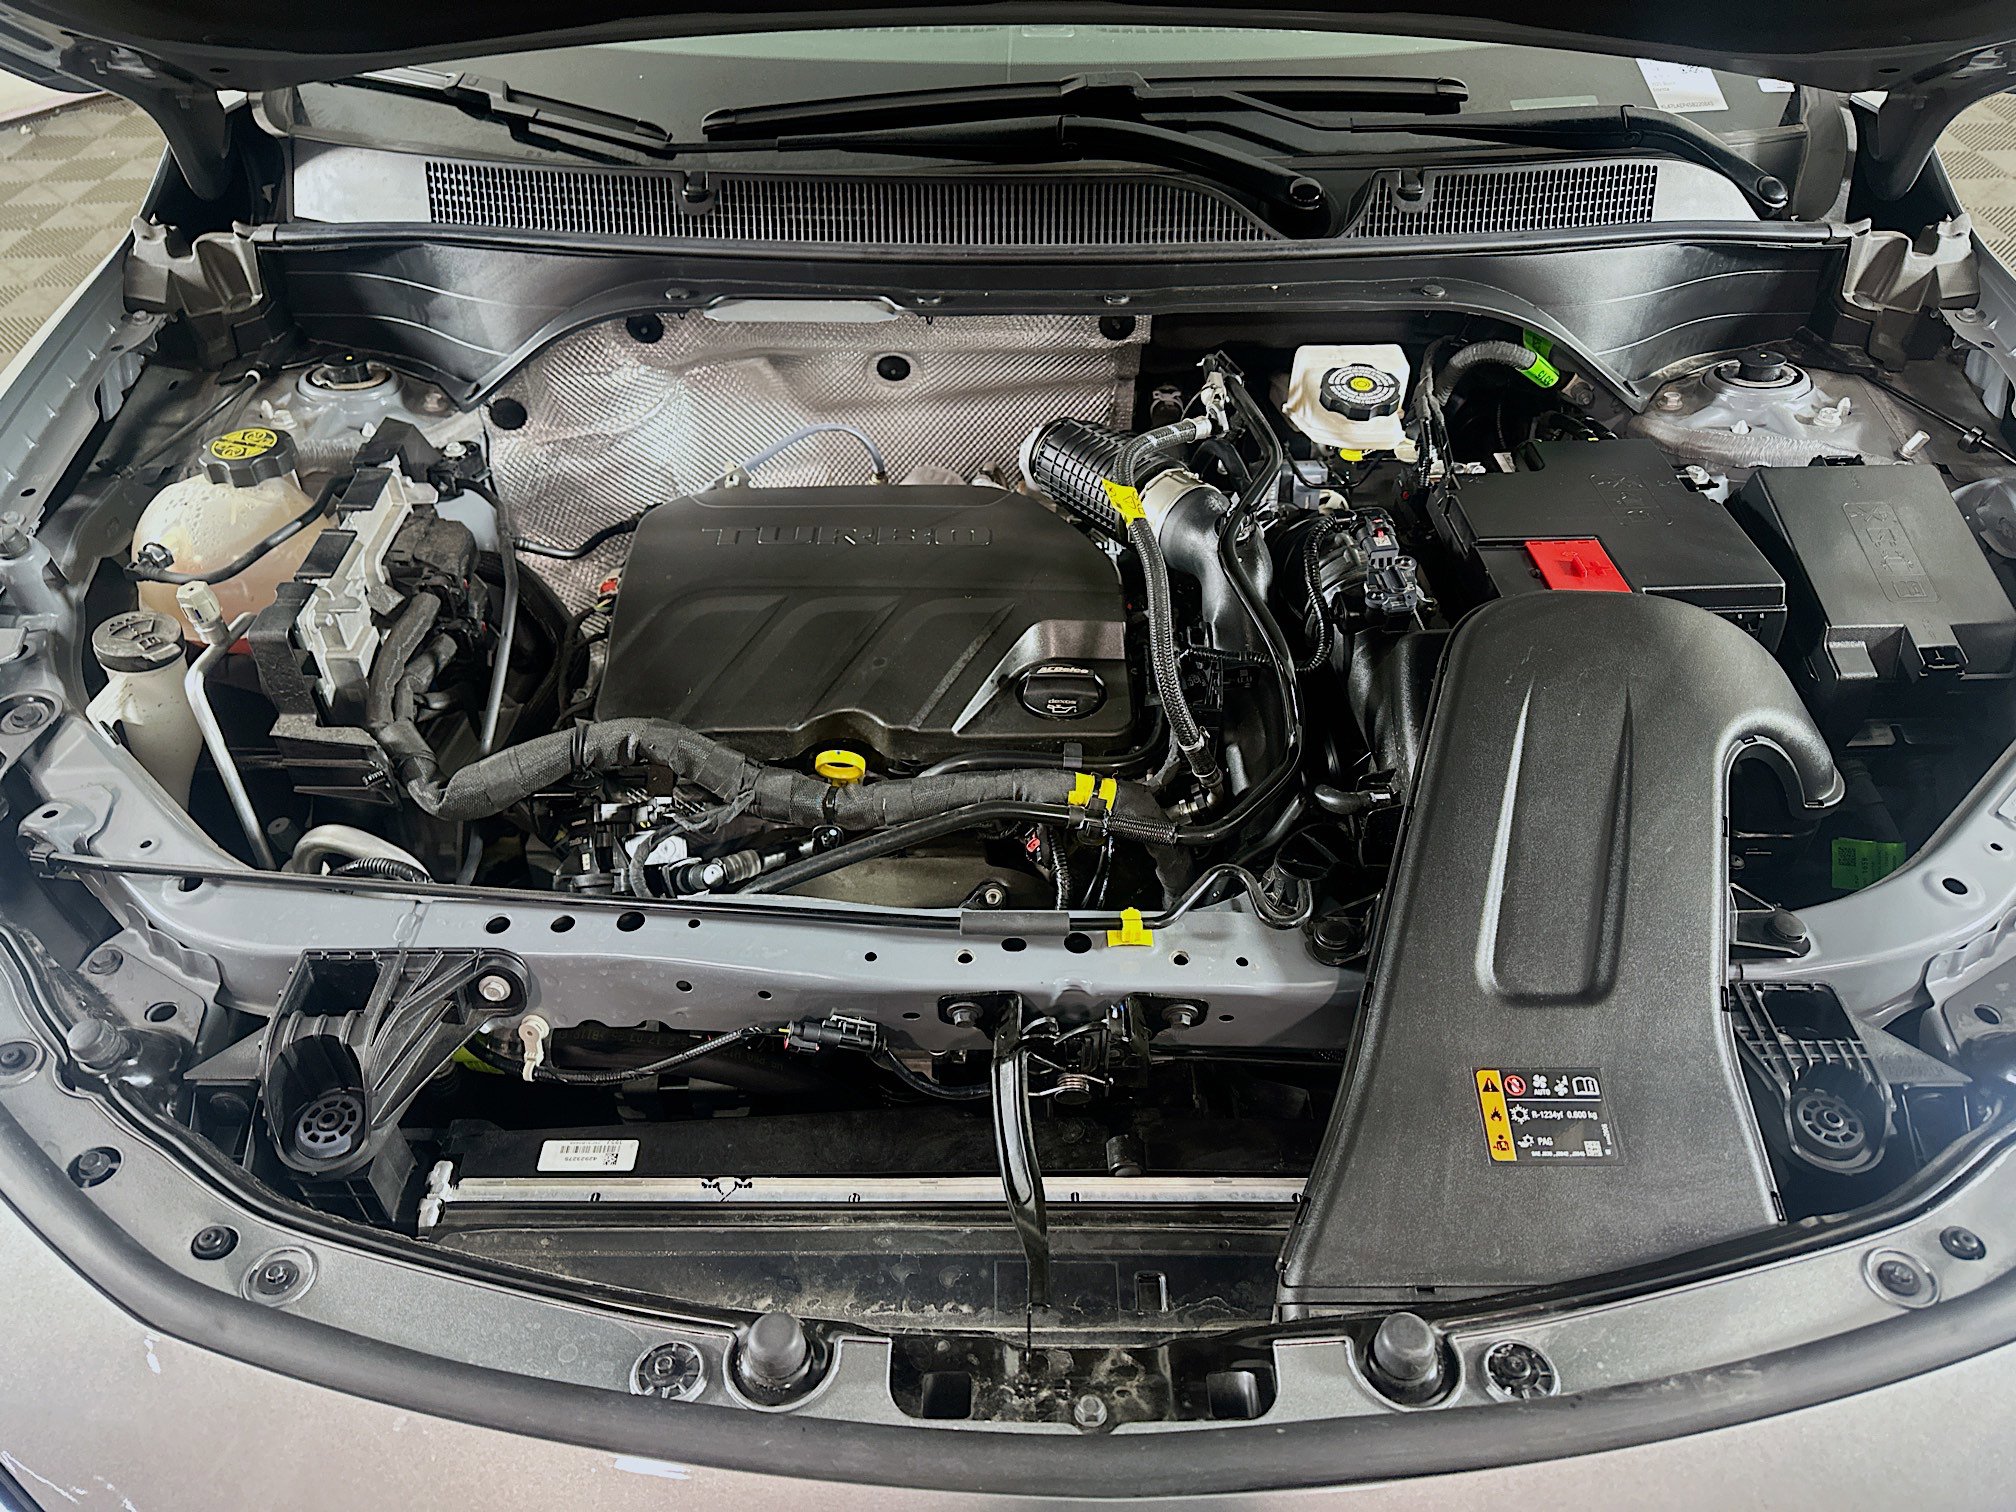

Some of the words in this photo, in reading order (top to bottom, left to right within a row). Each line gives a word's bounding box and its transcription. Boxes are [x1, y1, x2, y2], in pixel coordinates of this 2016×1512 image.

[701, 525, 993, 546] TURBO
[1036, 666, 1089, 674] ACDelco
[1587, 1110, 1598, 1120] kg
